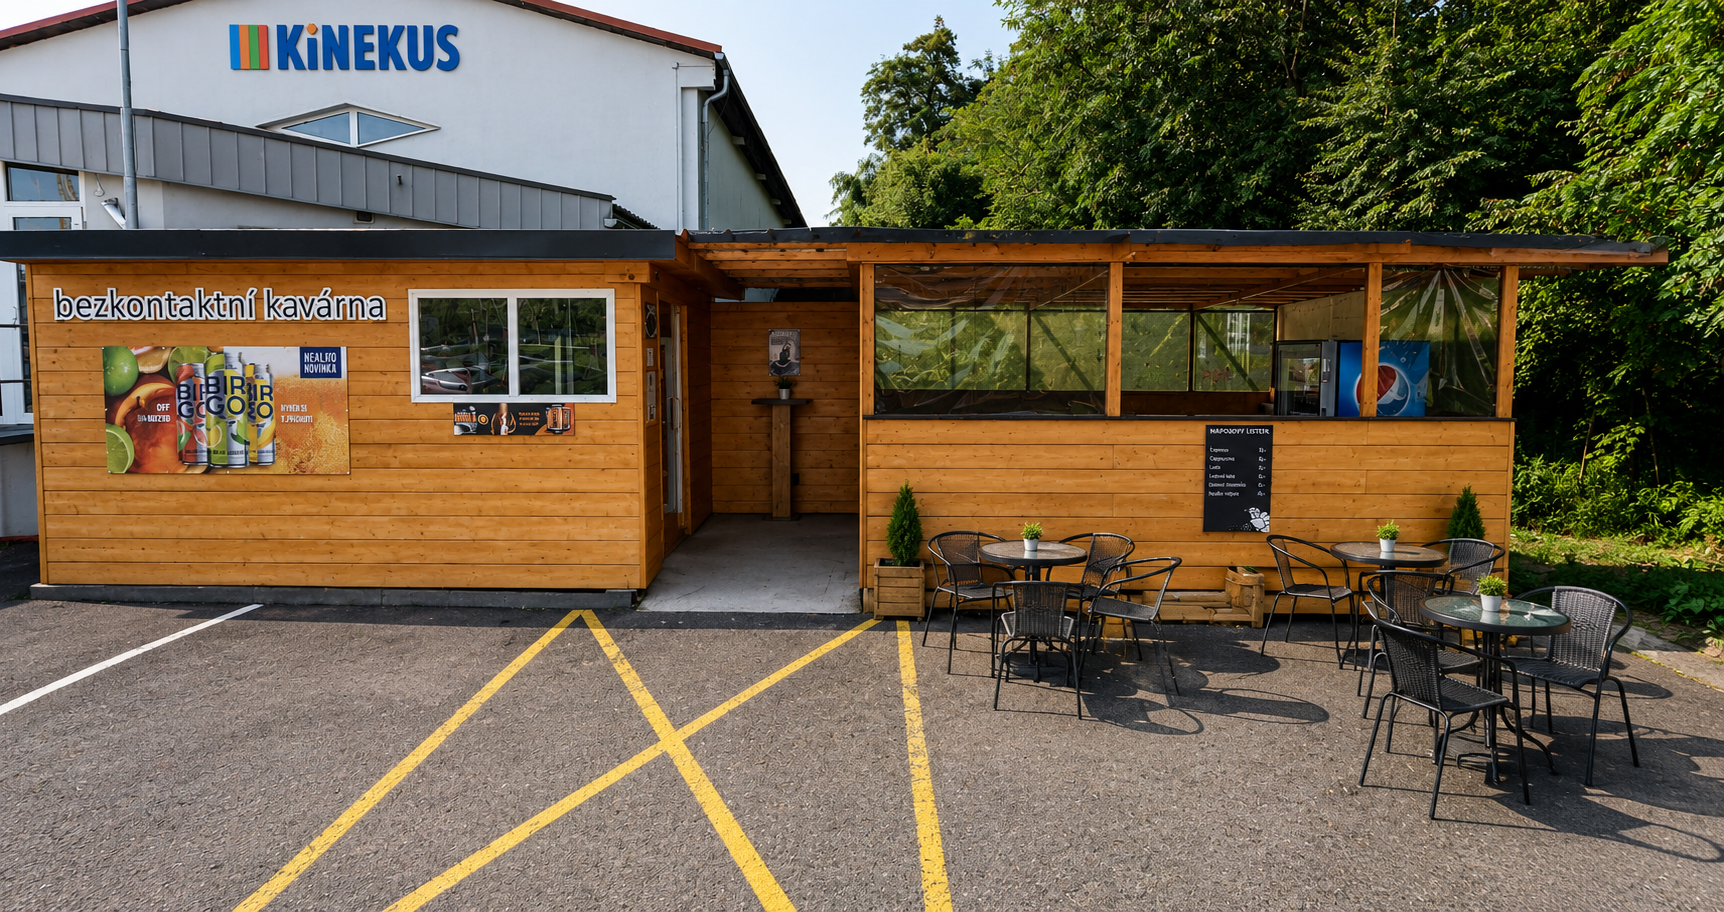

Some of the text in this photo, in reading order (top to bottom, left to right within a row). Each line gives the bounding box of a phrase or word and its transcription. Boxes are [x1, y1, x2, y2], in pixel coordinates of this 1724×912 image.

[53, 287, 386, 320] bezkontaktní kavárna
[206, 376, 246, 396] BIR
[206, 395, 246, 416] GO
